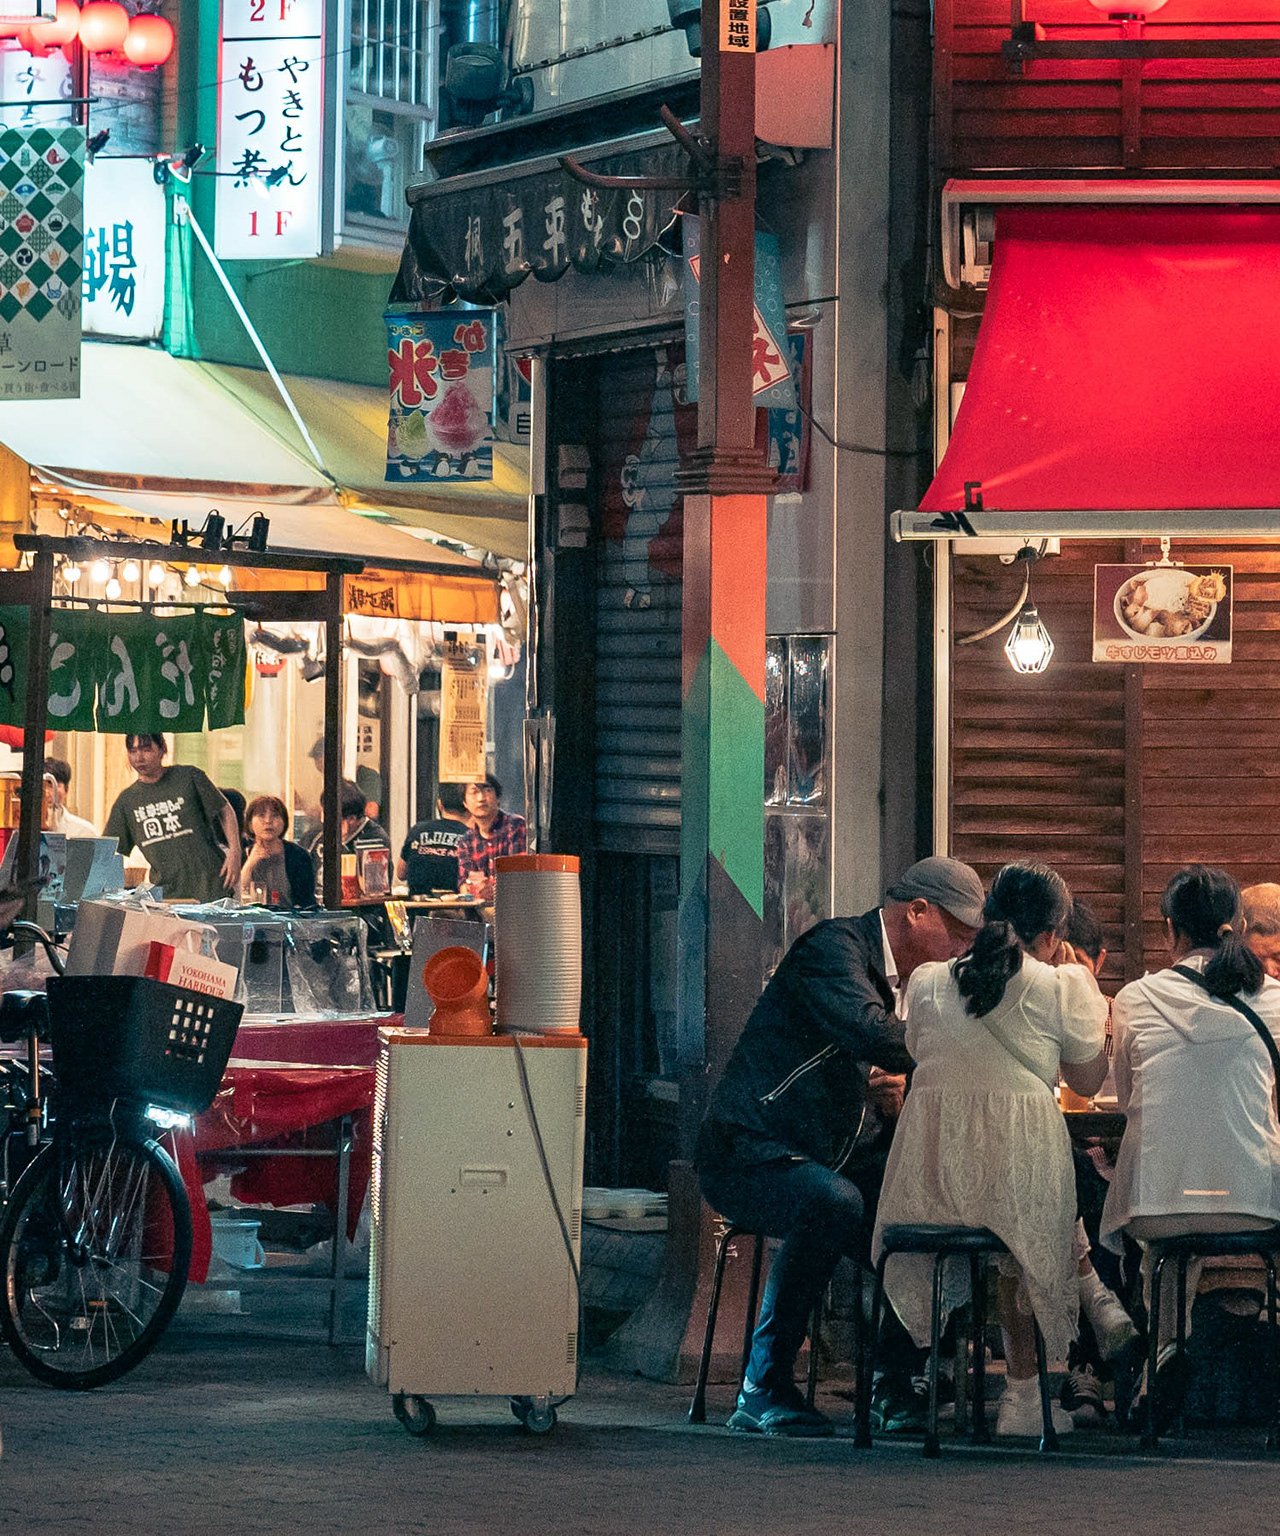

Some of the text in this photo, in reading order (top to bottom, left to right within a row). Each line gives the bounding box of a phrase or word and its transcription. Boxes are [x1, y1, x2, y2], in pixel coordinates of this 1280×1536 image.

[231, 56, 268, 189] もつ煮
[181, 965, 227, 988] YOKOHAMA
